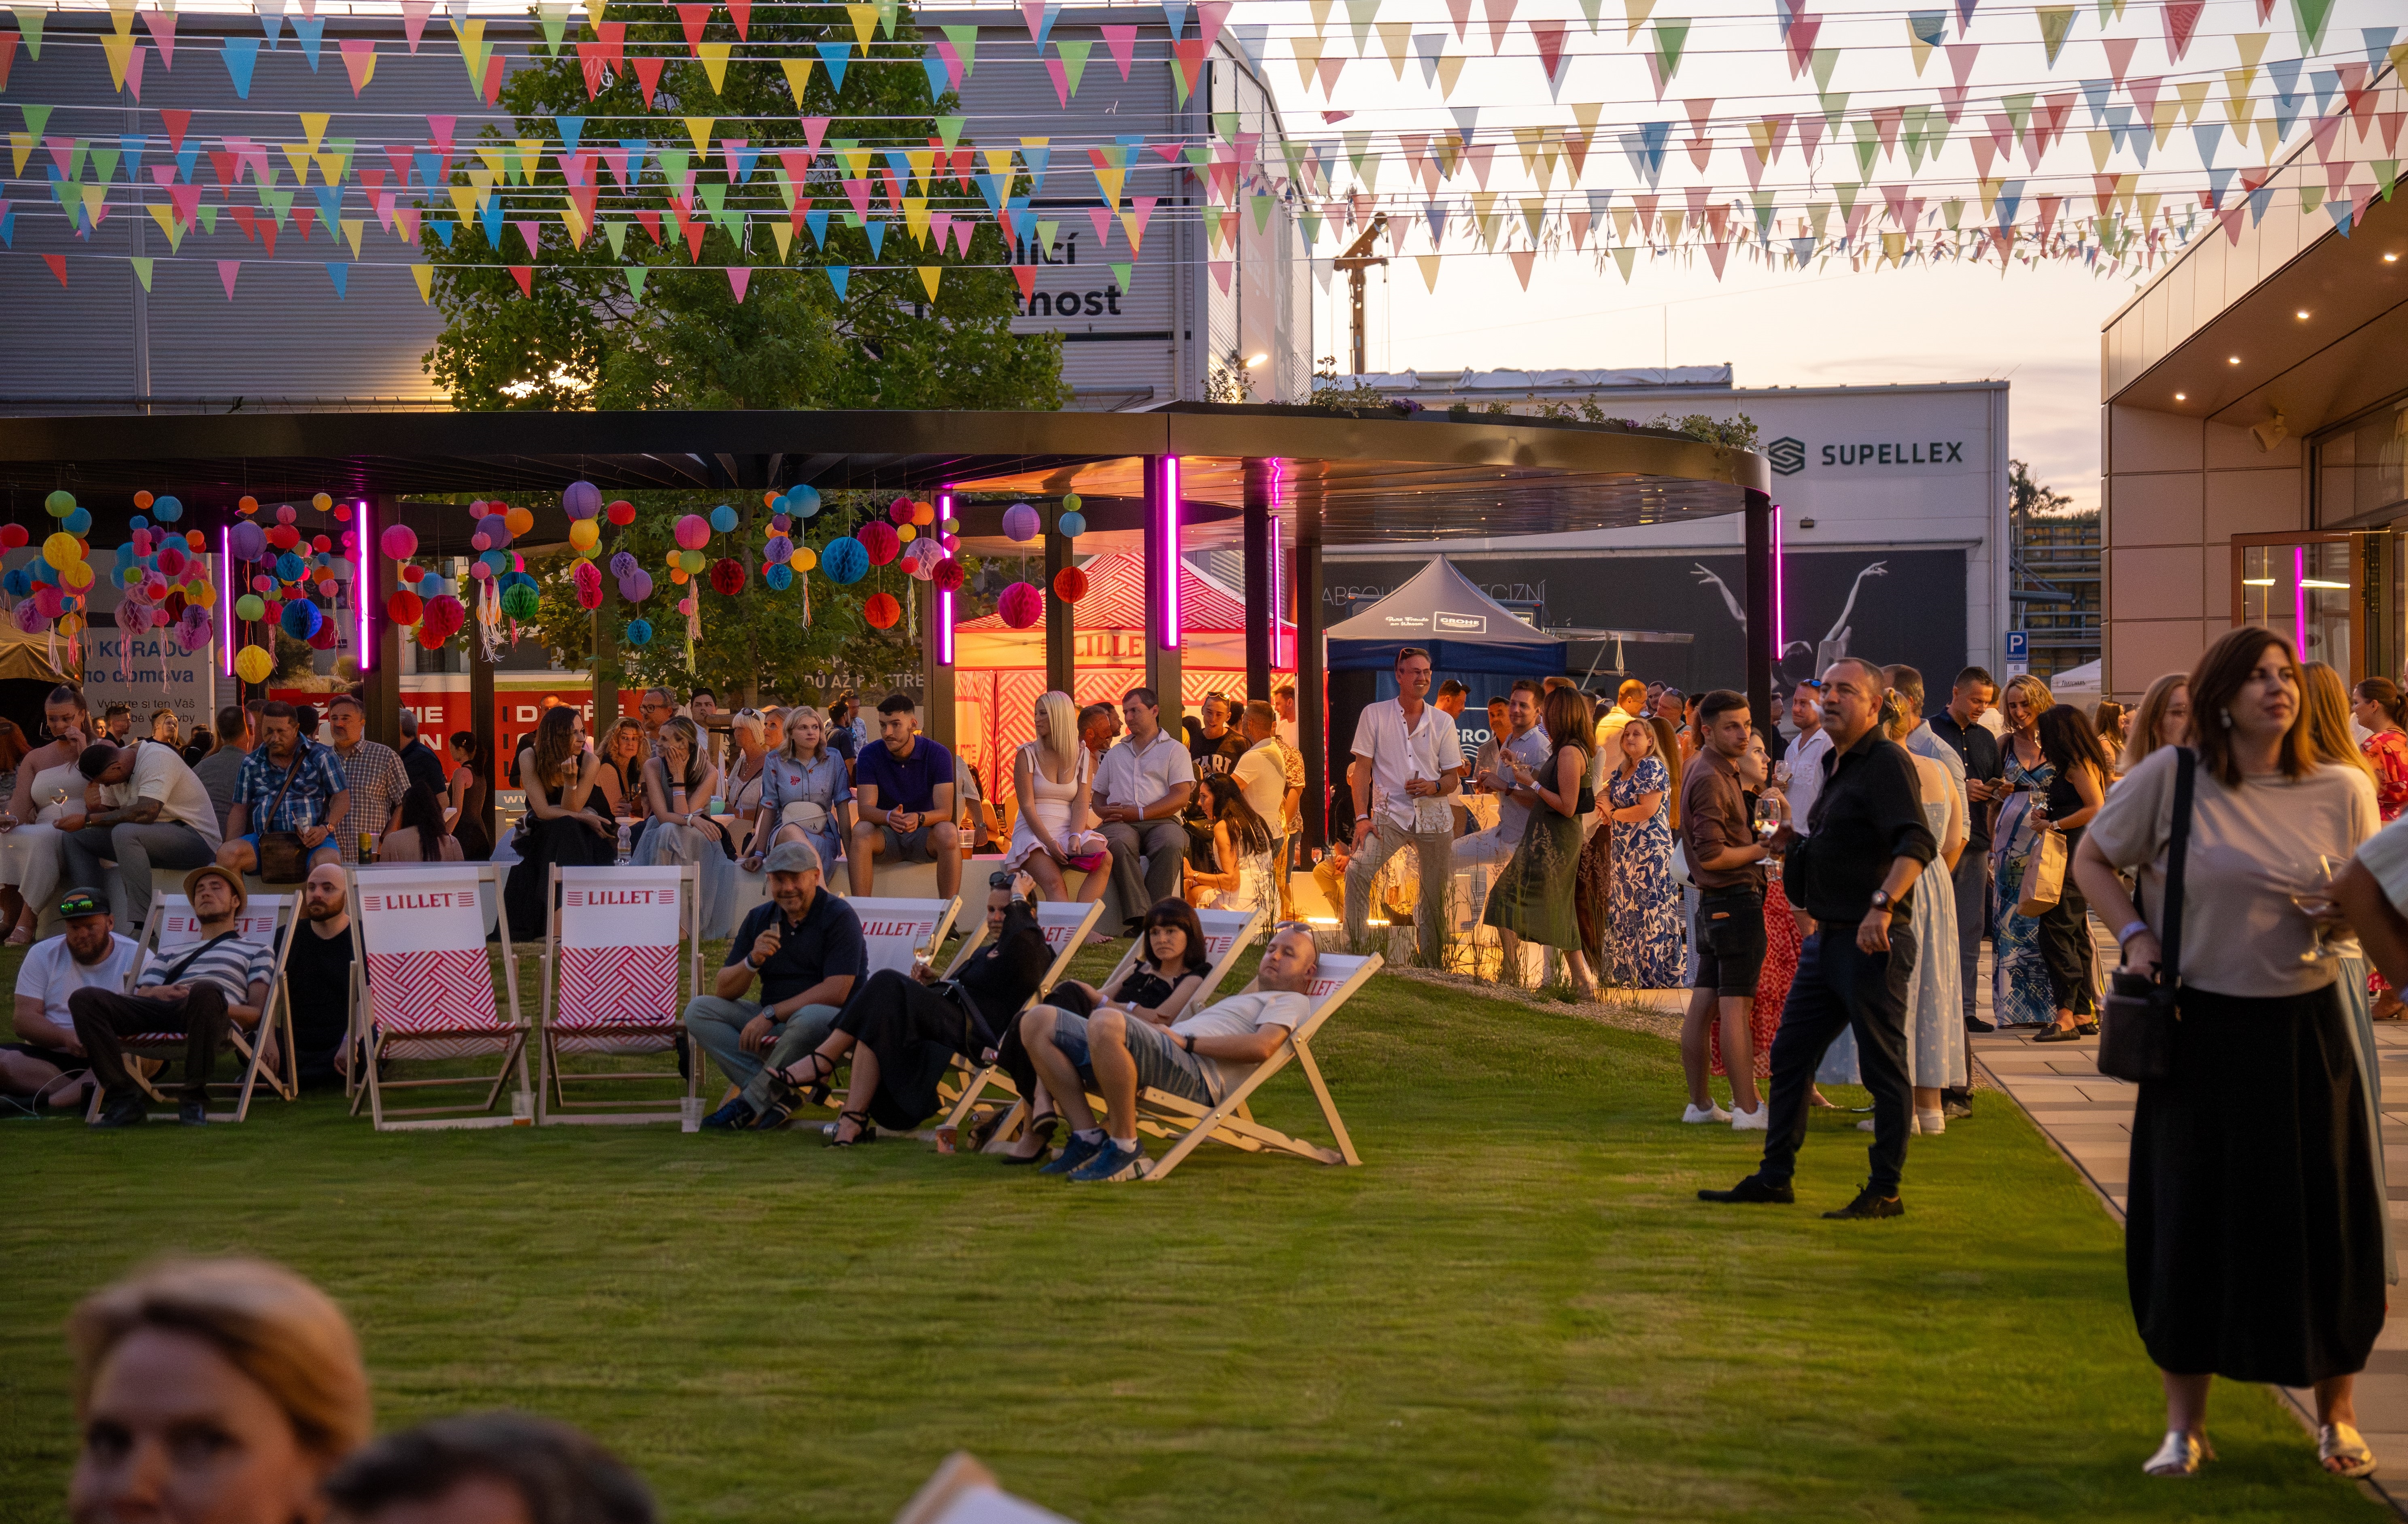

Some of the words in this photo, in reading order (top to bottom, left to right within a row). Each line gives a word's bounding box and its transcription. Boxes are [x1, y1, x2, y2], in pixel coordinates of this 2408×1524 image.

[1822, 441, 1963, 465] SUPELLEX
[1074, 636, 1145, 656] LILLE
[2011, 635, 2023, 652] P
[142, 700, 150, 708] si
[154, 700, 170, 708] ten
[174, 698, 195, 708] Váš
[386, 893, 452, 910] LILLET
[588, 891, 654, 905] LILLET
[862, 922, 918, 936] LILLET
